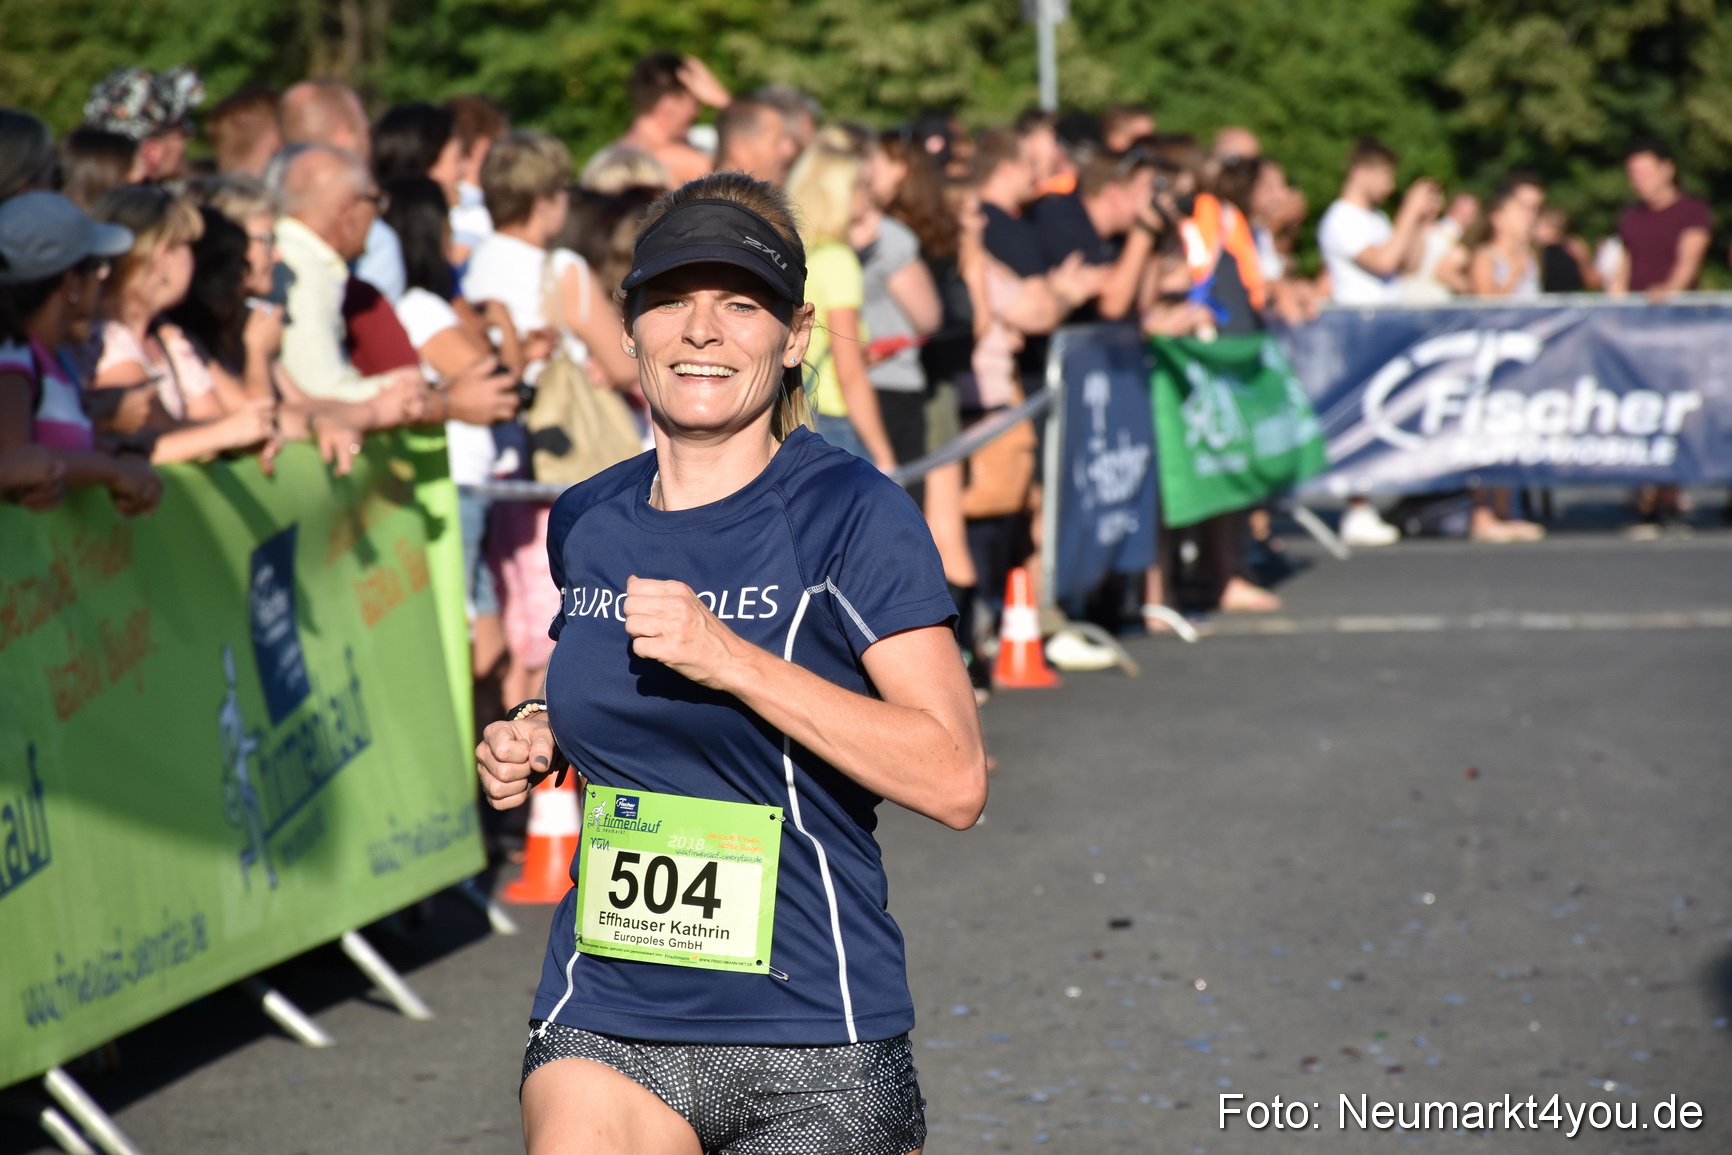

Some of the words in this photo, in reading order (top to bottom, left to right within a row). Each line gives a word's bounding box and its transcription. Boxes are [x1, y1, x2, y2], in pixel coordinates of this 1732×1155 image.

[1420, 374, 1702, 436] Fischer
[0, 742, 53, 898] auf
[603, 814, 662, 833] firmenlauf
[668, 835, 705, 850] 2018
[608, 851, 722, 920] 504
[598, 911, 665, 933] Effhauser
[670, 920, 730, 940] Kathrin
[614, 930, 665, 948] Europoles
[668, 937, 703, 951] GmbH
